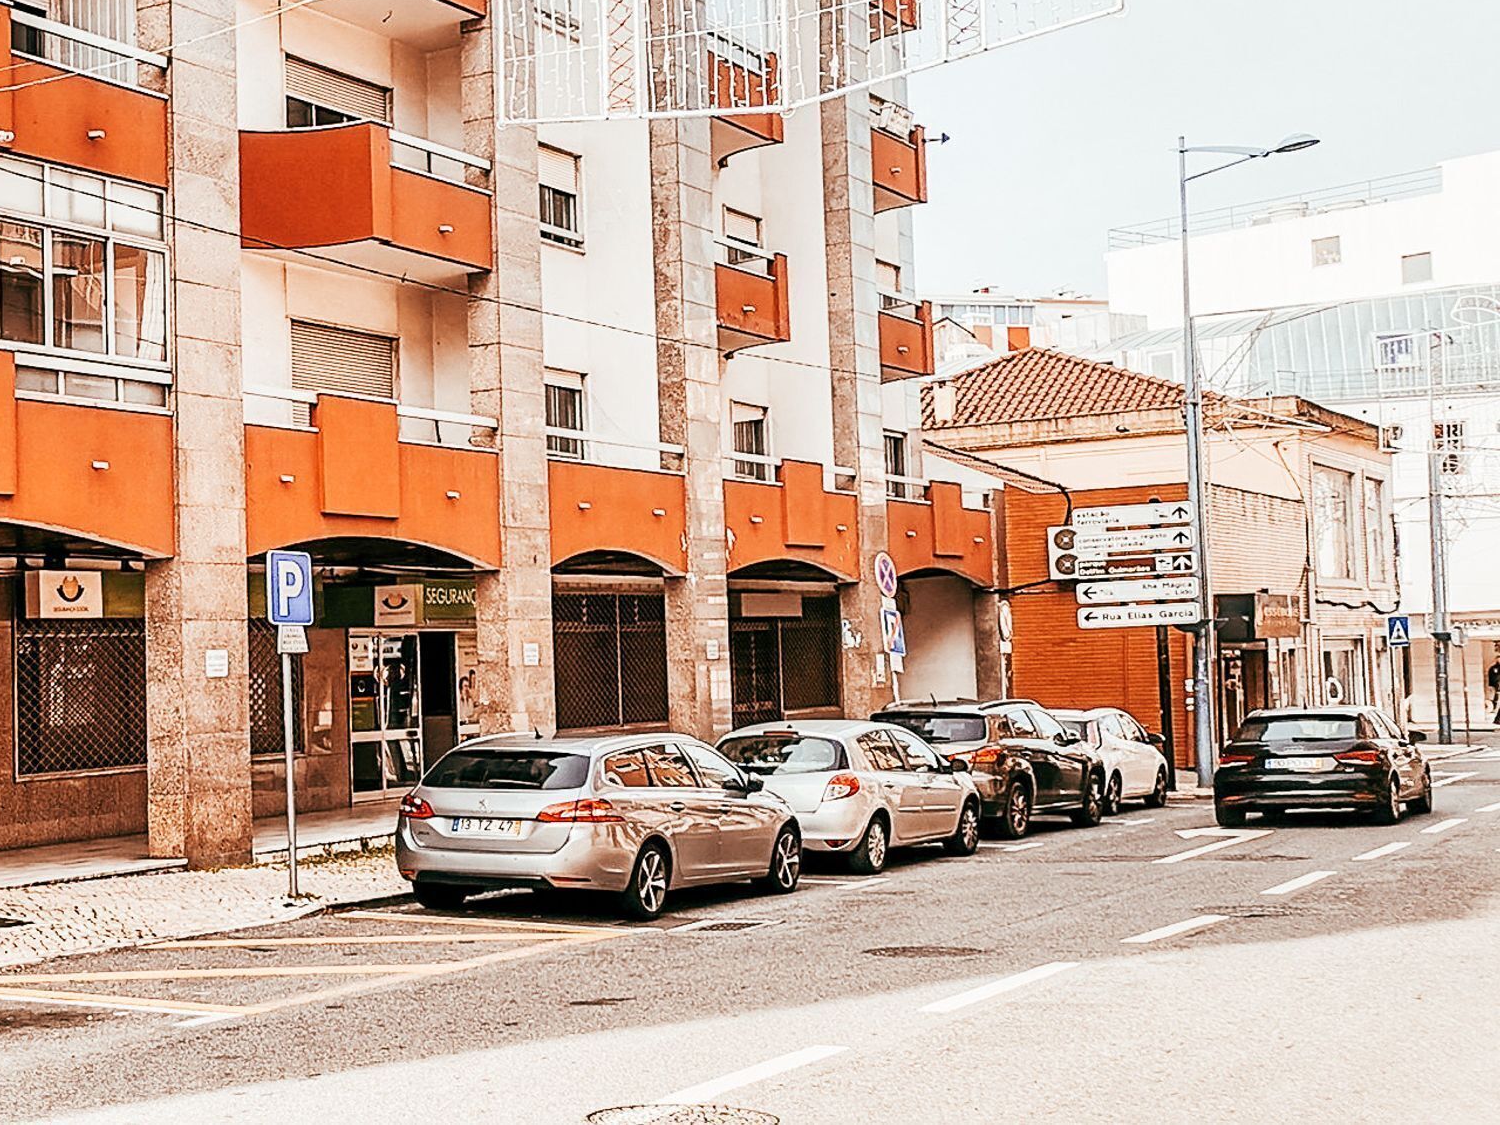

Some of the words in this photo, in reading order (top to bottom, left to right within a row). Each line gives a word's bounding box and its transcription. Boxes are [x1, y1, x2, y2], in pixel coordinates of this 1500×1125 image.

[278, 560, 304, 617] P
[1102, 613, 1122, 621] Rua
[1128, 611, 1154, 620] Elias
[1159, 609, 1193, 618] Garcia
